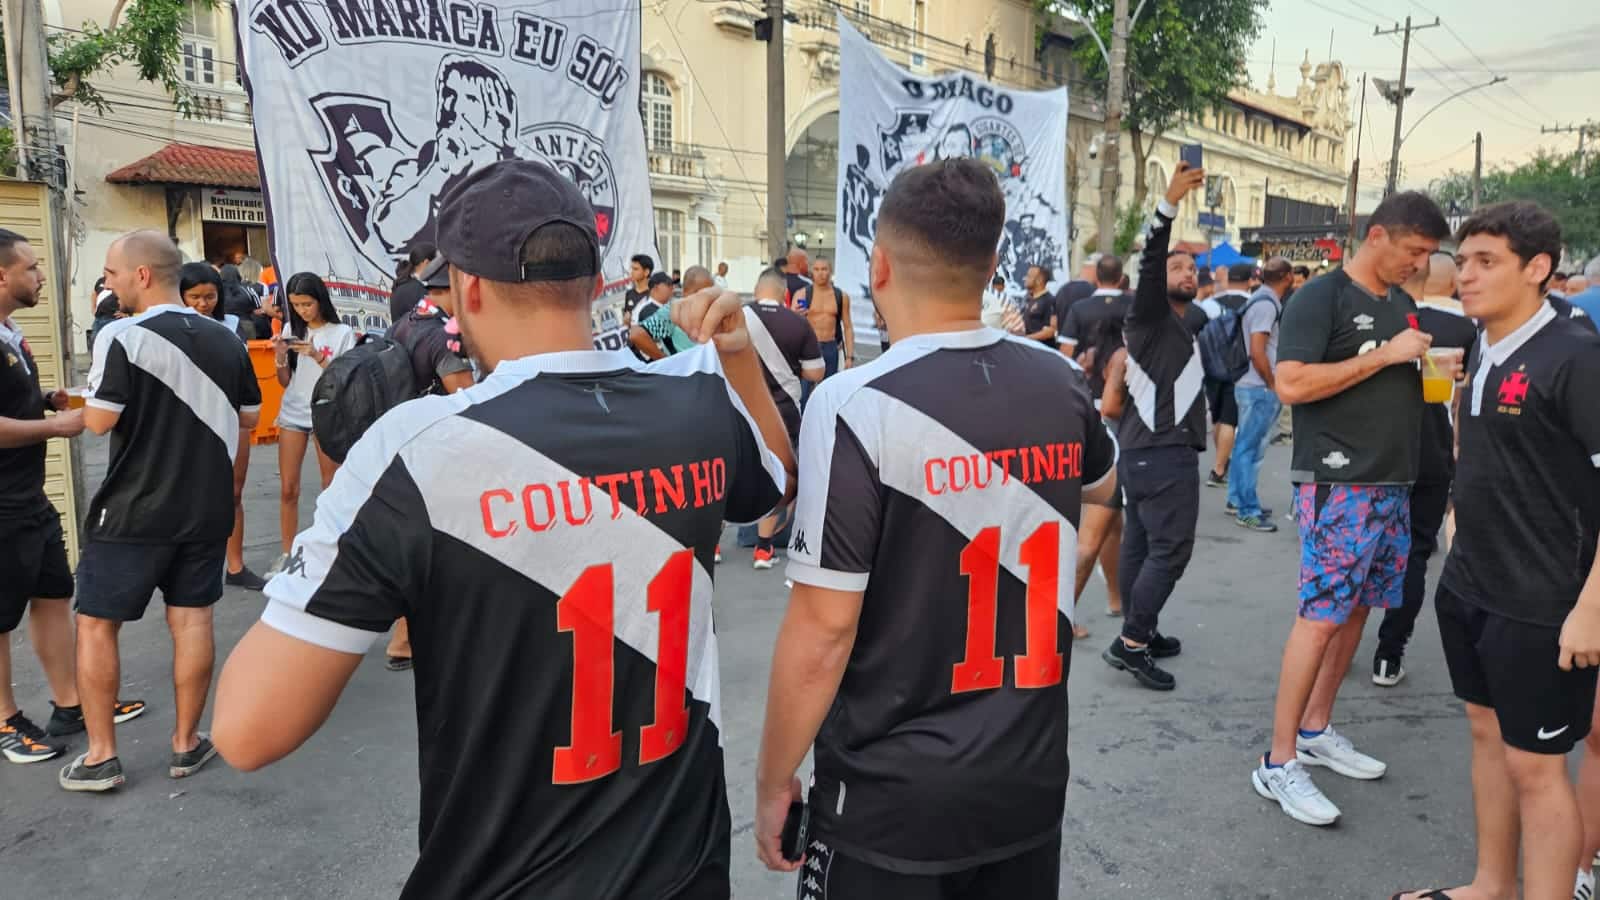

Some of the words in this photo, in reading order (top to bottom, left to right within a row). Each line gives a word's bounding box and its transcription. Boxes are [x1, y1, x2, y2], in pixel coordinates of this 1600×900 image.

[254, 0, 322, 61] NO
[515, 16, 563, 67] EU
[480, 457, 726, 539] COUTINHO
[924, 442, 1082, 496] COUTINHO
[952, 521, 1063, 694] 11
[552, 547, 694, 785] 11
